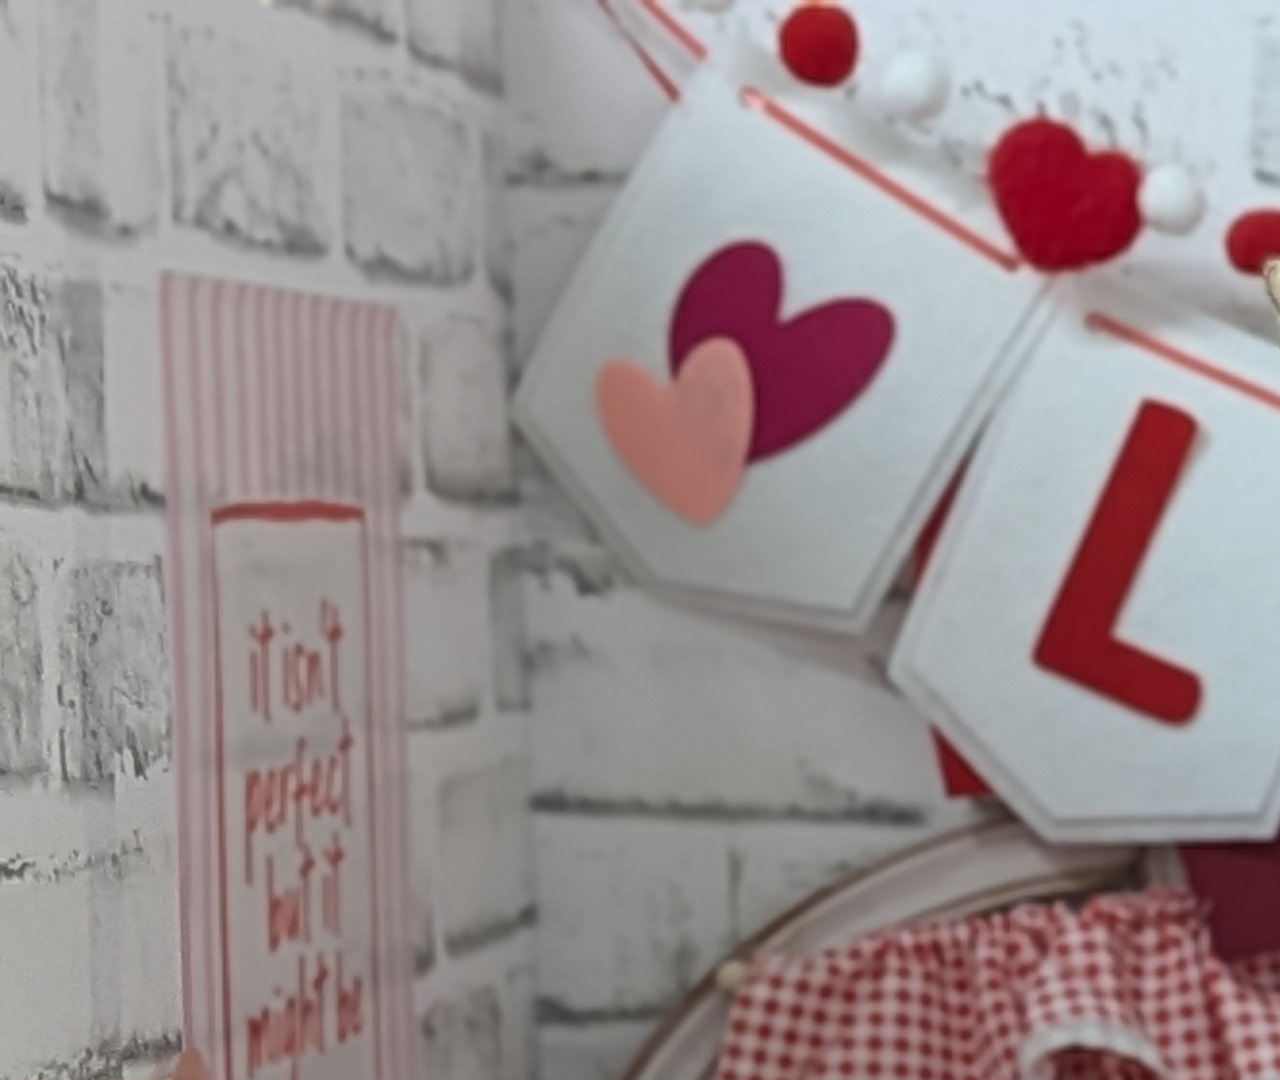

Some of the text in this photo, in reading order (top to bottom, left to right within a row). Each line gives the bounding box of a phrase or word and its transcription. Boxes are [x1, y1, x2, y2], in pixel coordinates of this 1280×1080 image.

[248, 609, 273, 724] it
[245, 716, 353, 886] perfect
[267, 832, 344, 953] but it
[335, 952, 362, 1044] be
